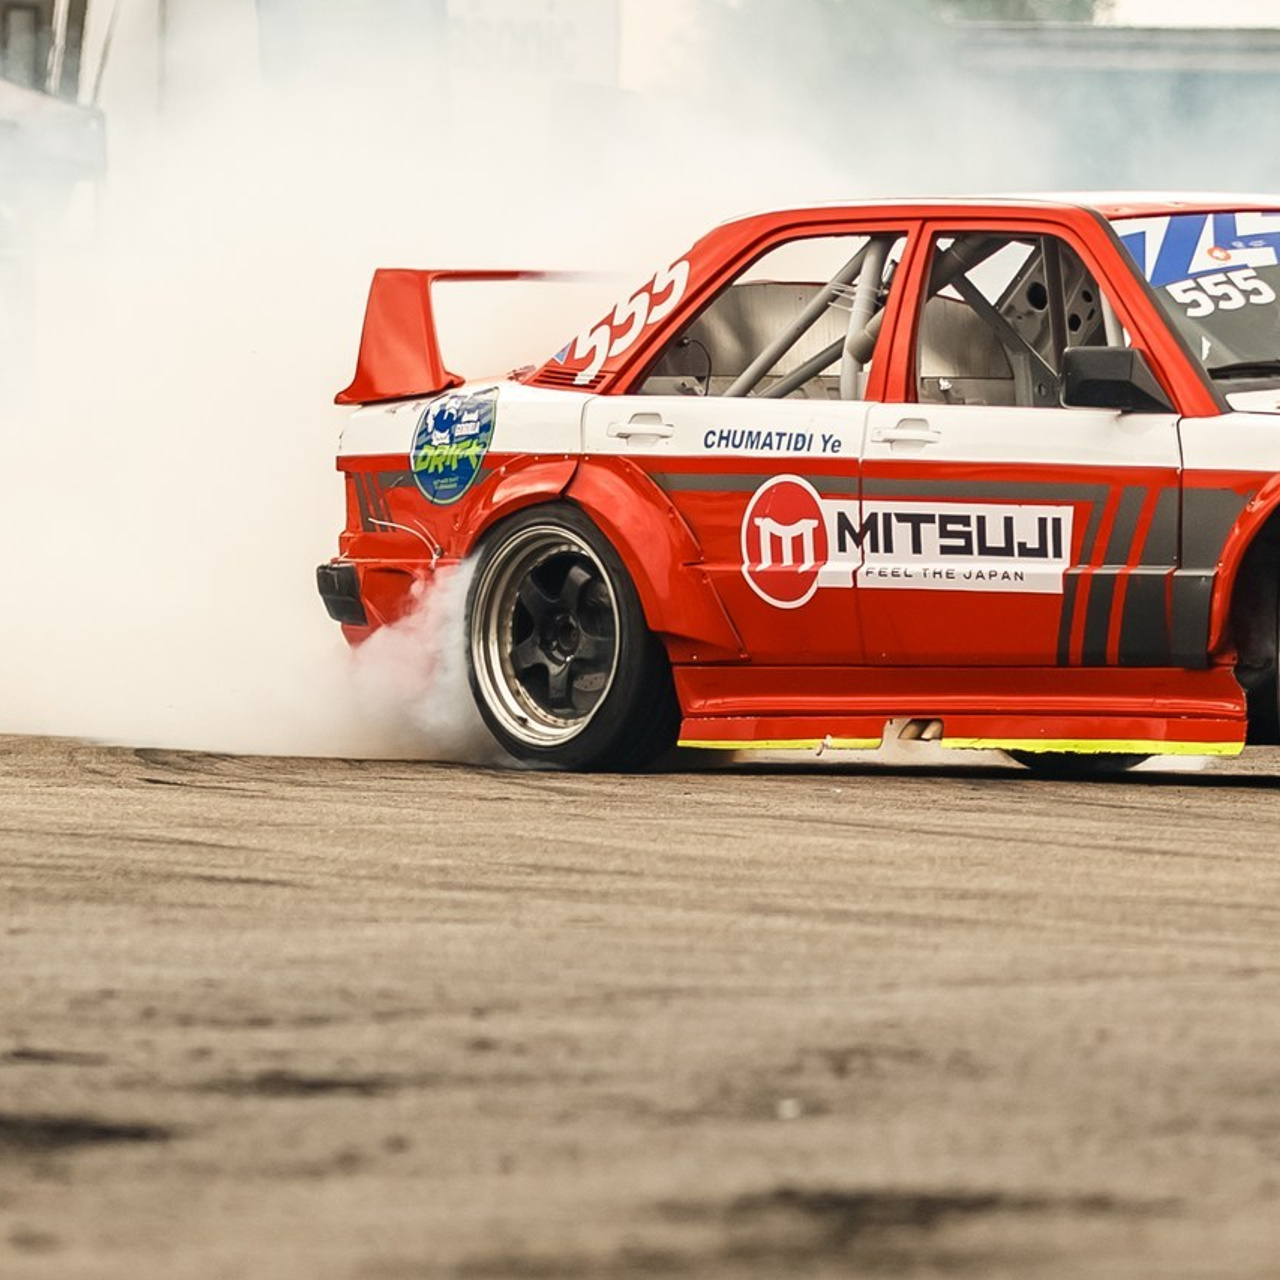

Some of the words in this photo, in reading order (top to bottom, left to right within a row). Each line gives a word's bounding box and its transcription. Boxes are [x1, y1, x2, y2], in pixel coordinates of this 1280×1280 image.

[1166, 269, 1277, 317] 555
[572, 259, 691, 385] 555
[703, 429, 814, 452] CHUMATIDI
[821, 433, 842, 453] Ye
[837, 510, 1063, 559] MITSUJI
[865, 566, 912, 579] FEEL
[922, 567, 956, 580] THE
[963, 568, 1025, 582] JAPAN
